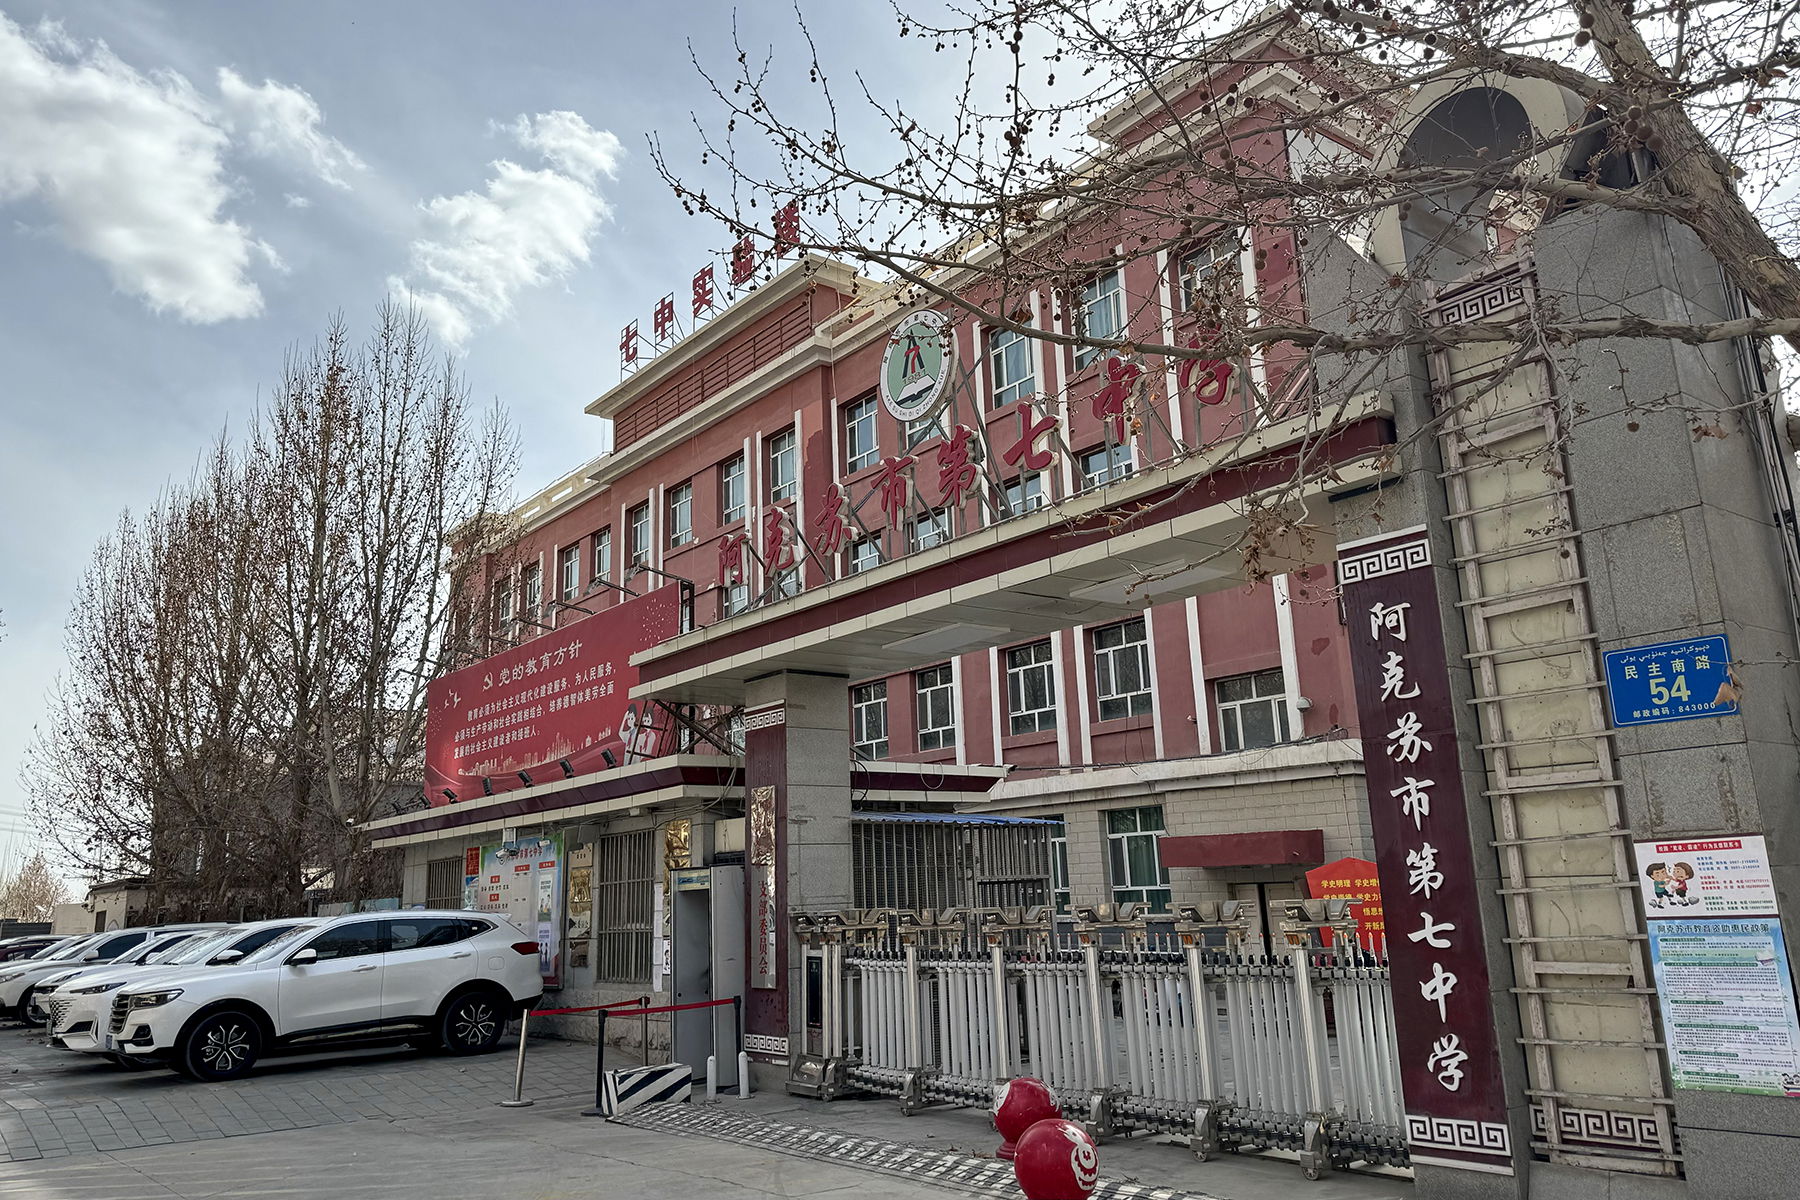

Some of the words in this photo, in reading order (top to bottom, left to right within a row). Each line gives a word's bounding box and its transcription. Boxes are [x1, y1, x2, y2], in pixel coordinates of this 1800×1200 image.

[498, 640, 582, 687] 党的教育方针
[1625, 654, 1710, 680] 民主南路
[1650, 675, 1691, 705] 54
[1369, 602, 1468, 1092] 阿克苏市第七中学
[1321, 879, 1351, 888] 学史明理
[1354, 878, 1379, 888] 学史增
[1356, 892, 1381, 902] 学史力
